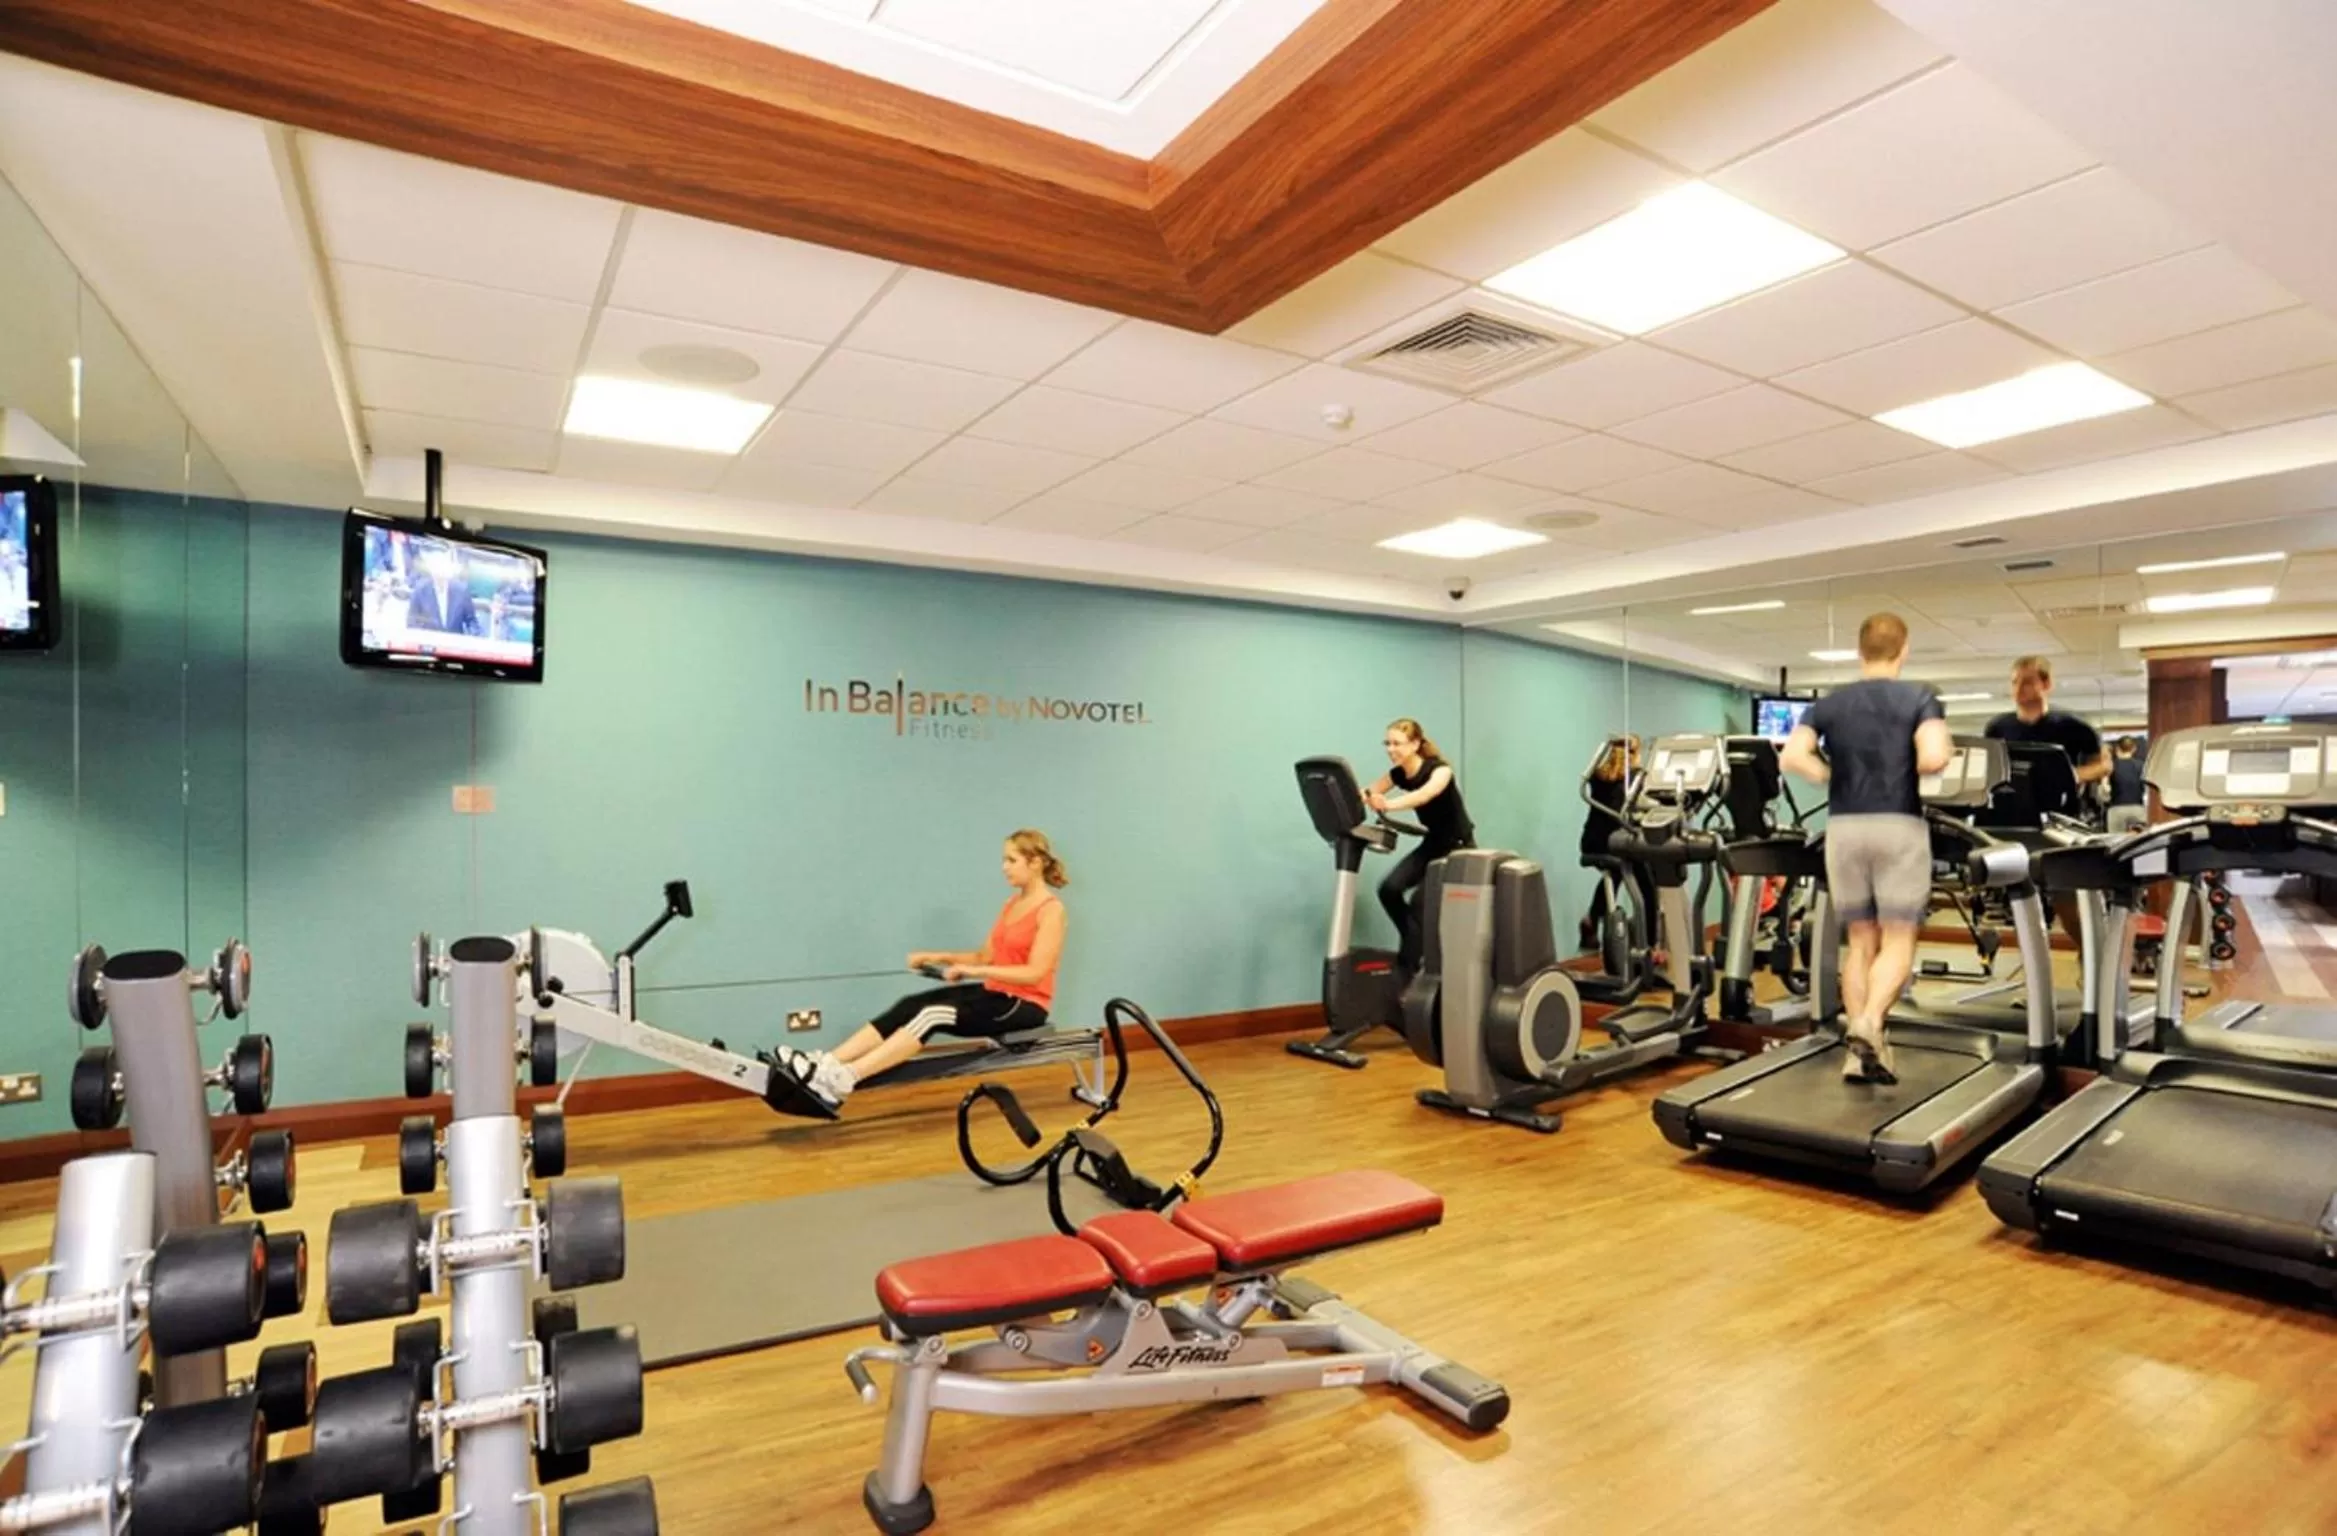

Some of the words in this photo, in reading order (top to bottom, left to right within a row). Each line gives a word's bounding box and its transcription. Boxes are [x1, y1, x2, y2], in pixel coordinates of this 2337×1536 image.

[805, 679, 838, 712] In
[848, 679, 989, 735] Balance
[1028, 697, 1152, 724] NOVOTEL
